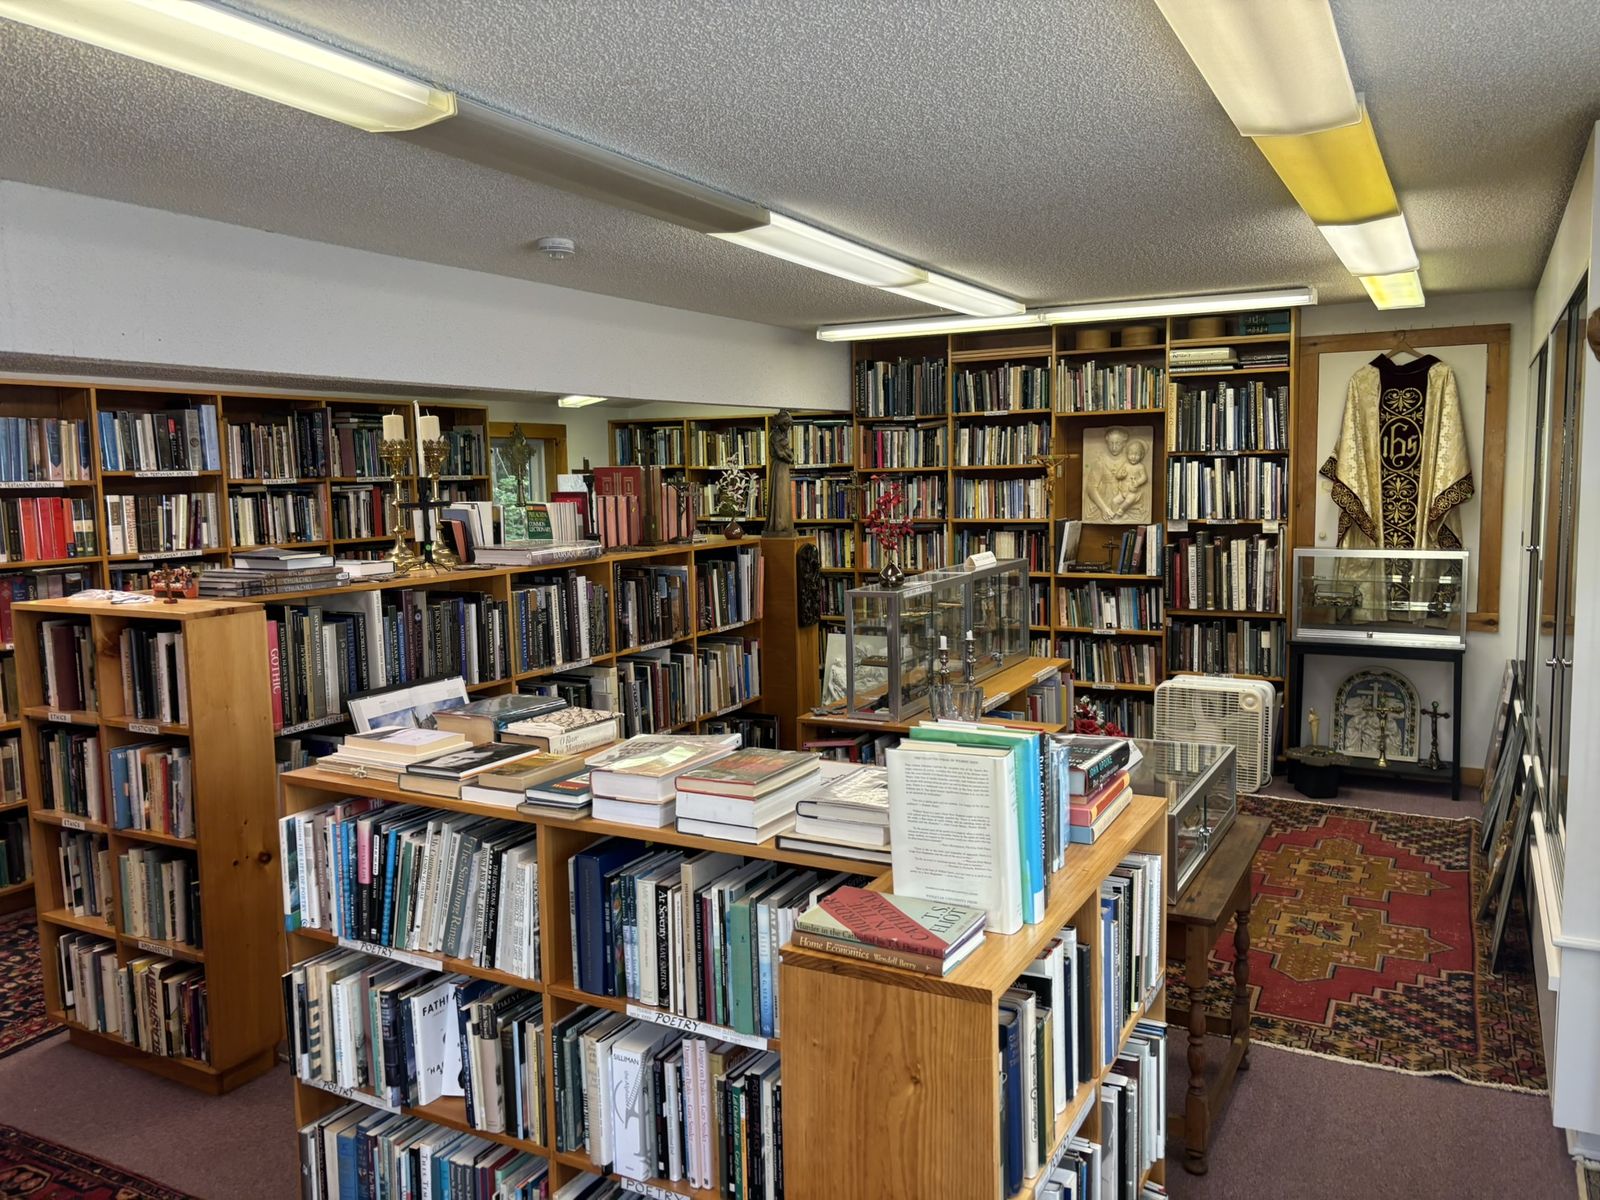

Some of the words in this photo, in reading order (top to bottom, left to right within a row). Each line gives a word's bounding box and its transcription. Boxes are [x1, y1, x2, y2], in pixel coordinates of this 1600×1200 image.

[270, 648, 281, 694] GOTHIC
[461, 837, 474, 863] The
[480, 847, 489, 868] HONEY
[300, 876, 305, 885] OF
[452, 864, 469, 914] Sandburg
[658, 890, 667, 903] At
[475, 903, 483, 919] CARL
[658, 905, 668, 939] Seventy
[825, 897, 874, 932] MURDER
[860, 893, 929, 941] CATHEDRAL
[922, 906, 950, 923] T.S.
[930, 908, 967, 933] ELIOT
[447, 915, 462, 950] Range
[474, 920, 482, 954] SANDBURG
[796, 921, 820, 932] Murder
[821, 924, 828, 932] in
[829, 926, 840, 934] the
[359, 943, 394, 958] POETRY
[800, 935, 824, 950] Home
[826, 941, 870, 960] Economics
[874, 953, 898, 965] Wendell
[899, 959, 917, 970] Berry
[148, 966, 164, 1055] BLASPHEMY
[654, 1012, 701, 1032] POETRY
[613, 1053, 639, 1065] SILLIMAN
[684, 1045, 692, 1068] Danger
[698, 1046, 706, 1069] Danger
[686, 1069, 691, 1077] on
[700, 1070, 705, 1078] on
[322, 1080, 354, 1097] POETRY
[626, 1181, 685, 1200] POETRY
